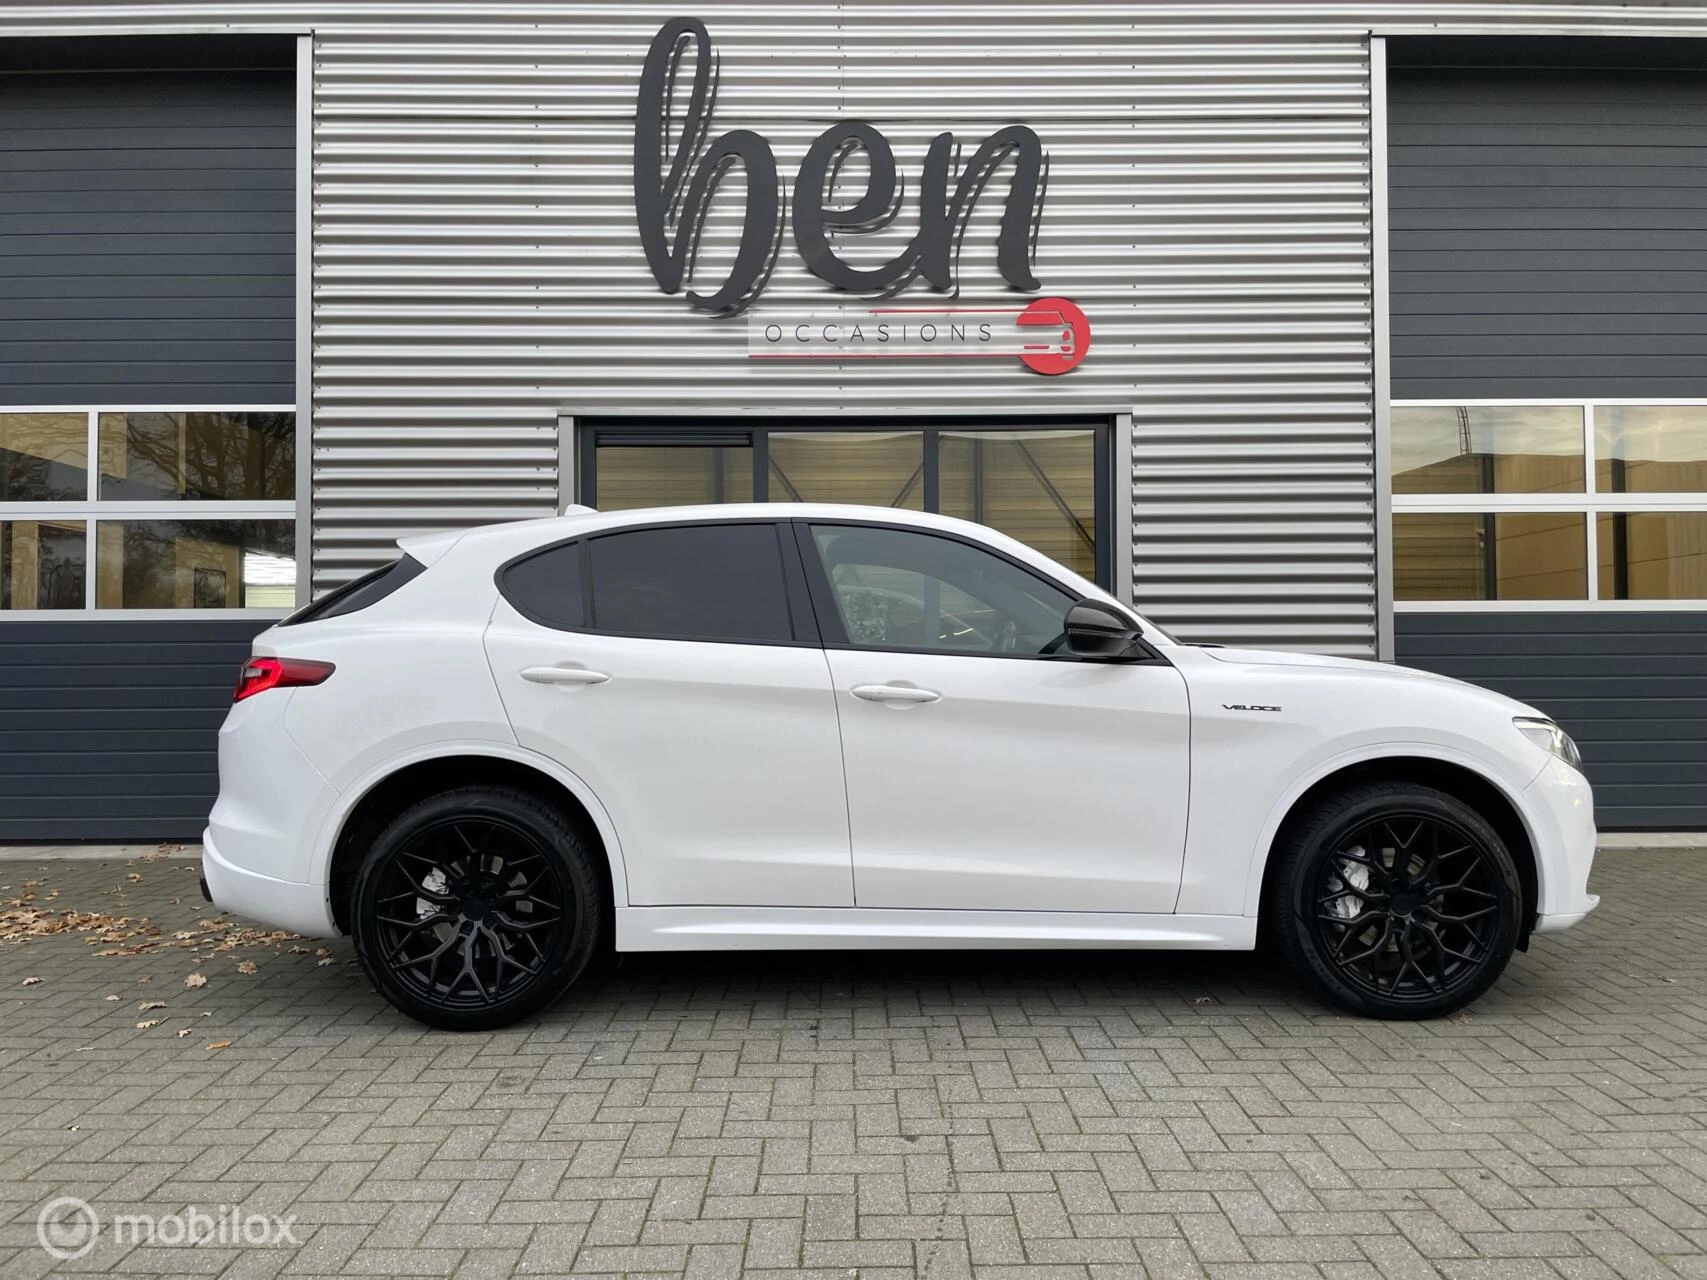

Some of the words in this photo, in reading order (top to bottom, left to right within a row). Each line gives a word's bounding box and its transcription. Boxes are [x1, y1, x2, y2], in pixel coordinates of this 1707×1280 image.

[634, 17, 1049, 318] ben
[765, 324, 992, 343] OCCASIONS
[1222, 704, 1282, 712] VELOCE
